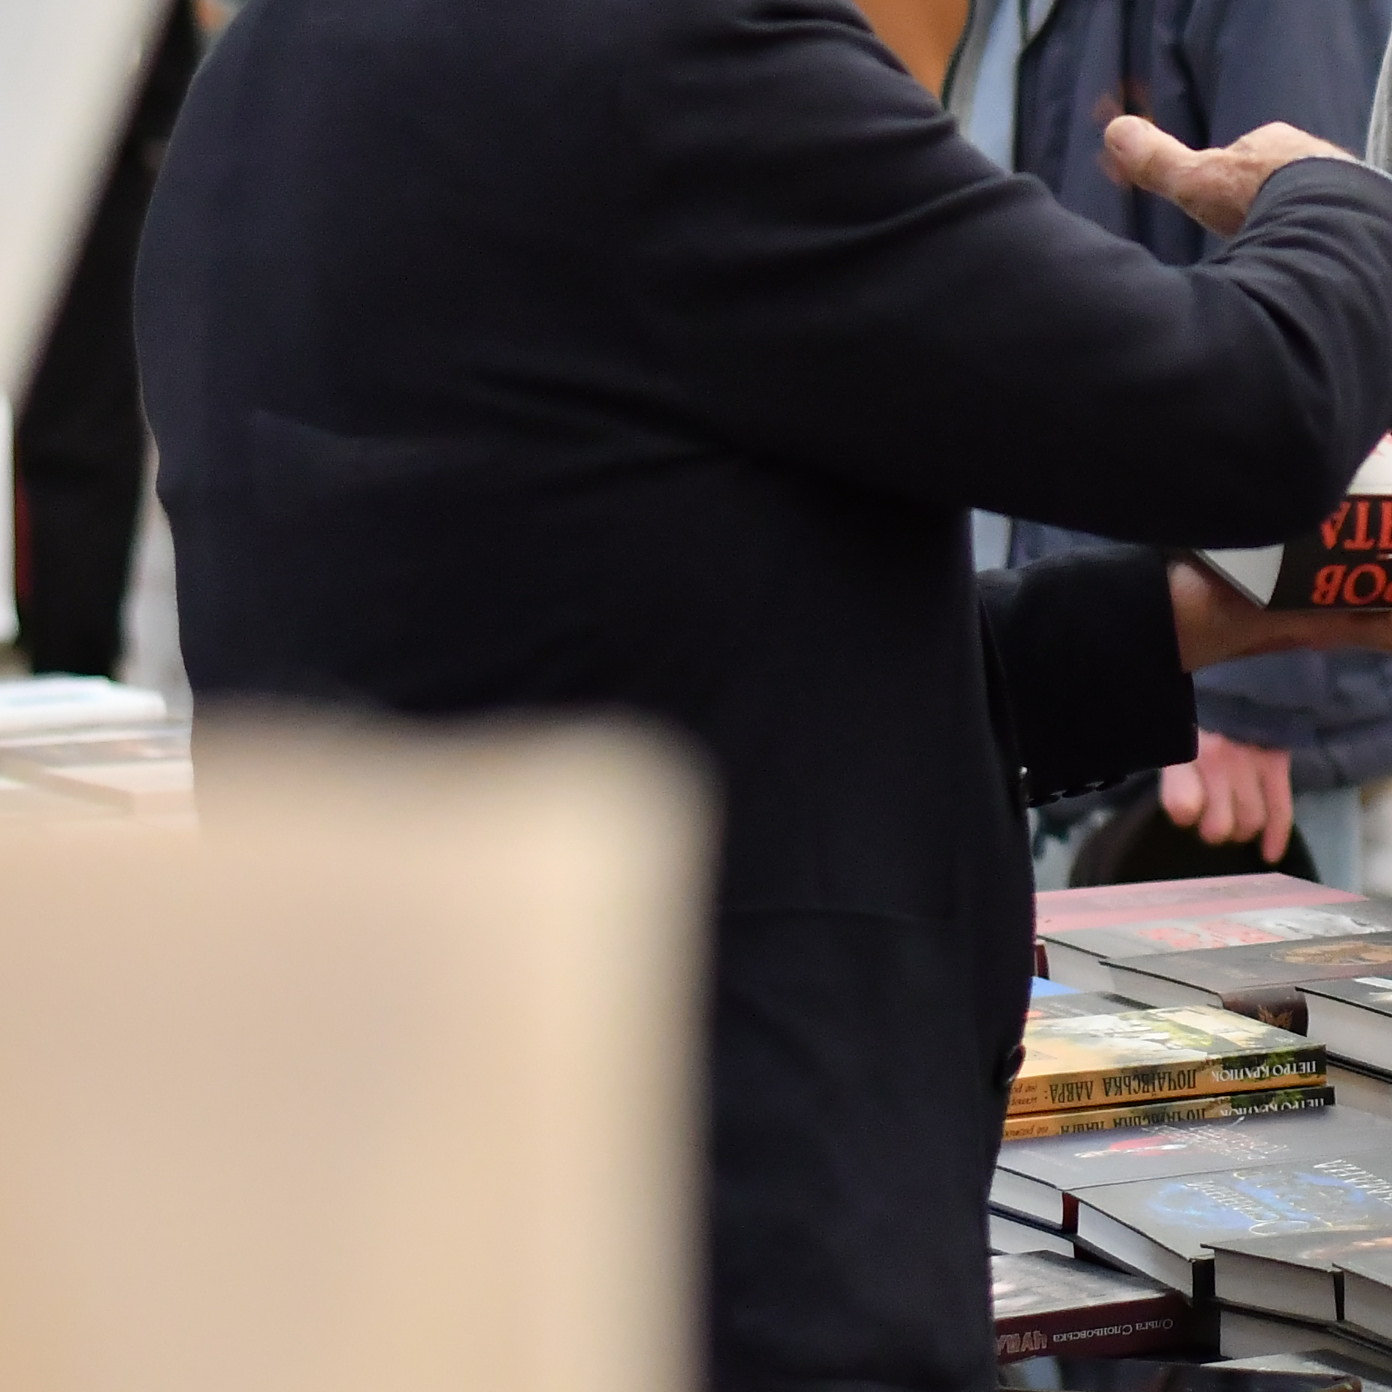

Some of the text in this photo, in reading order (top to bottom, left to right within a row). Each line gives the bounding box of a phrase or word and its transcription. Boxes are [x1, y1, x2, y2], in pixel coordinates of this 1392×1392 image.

[1102, 1069, 1198, 1097] ПОЧАЇВСЬКА
[1211, 1060, 1317, 1082] ПЕТРО КРАЛЮК
[1052, 1318, 1174, 1344] Ольга Слоньовська
